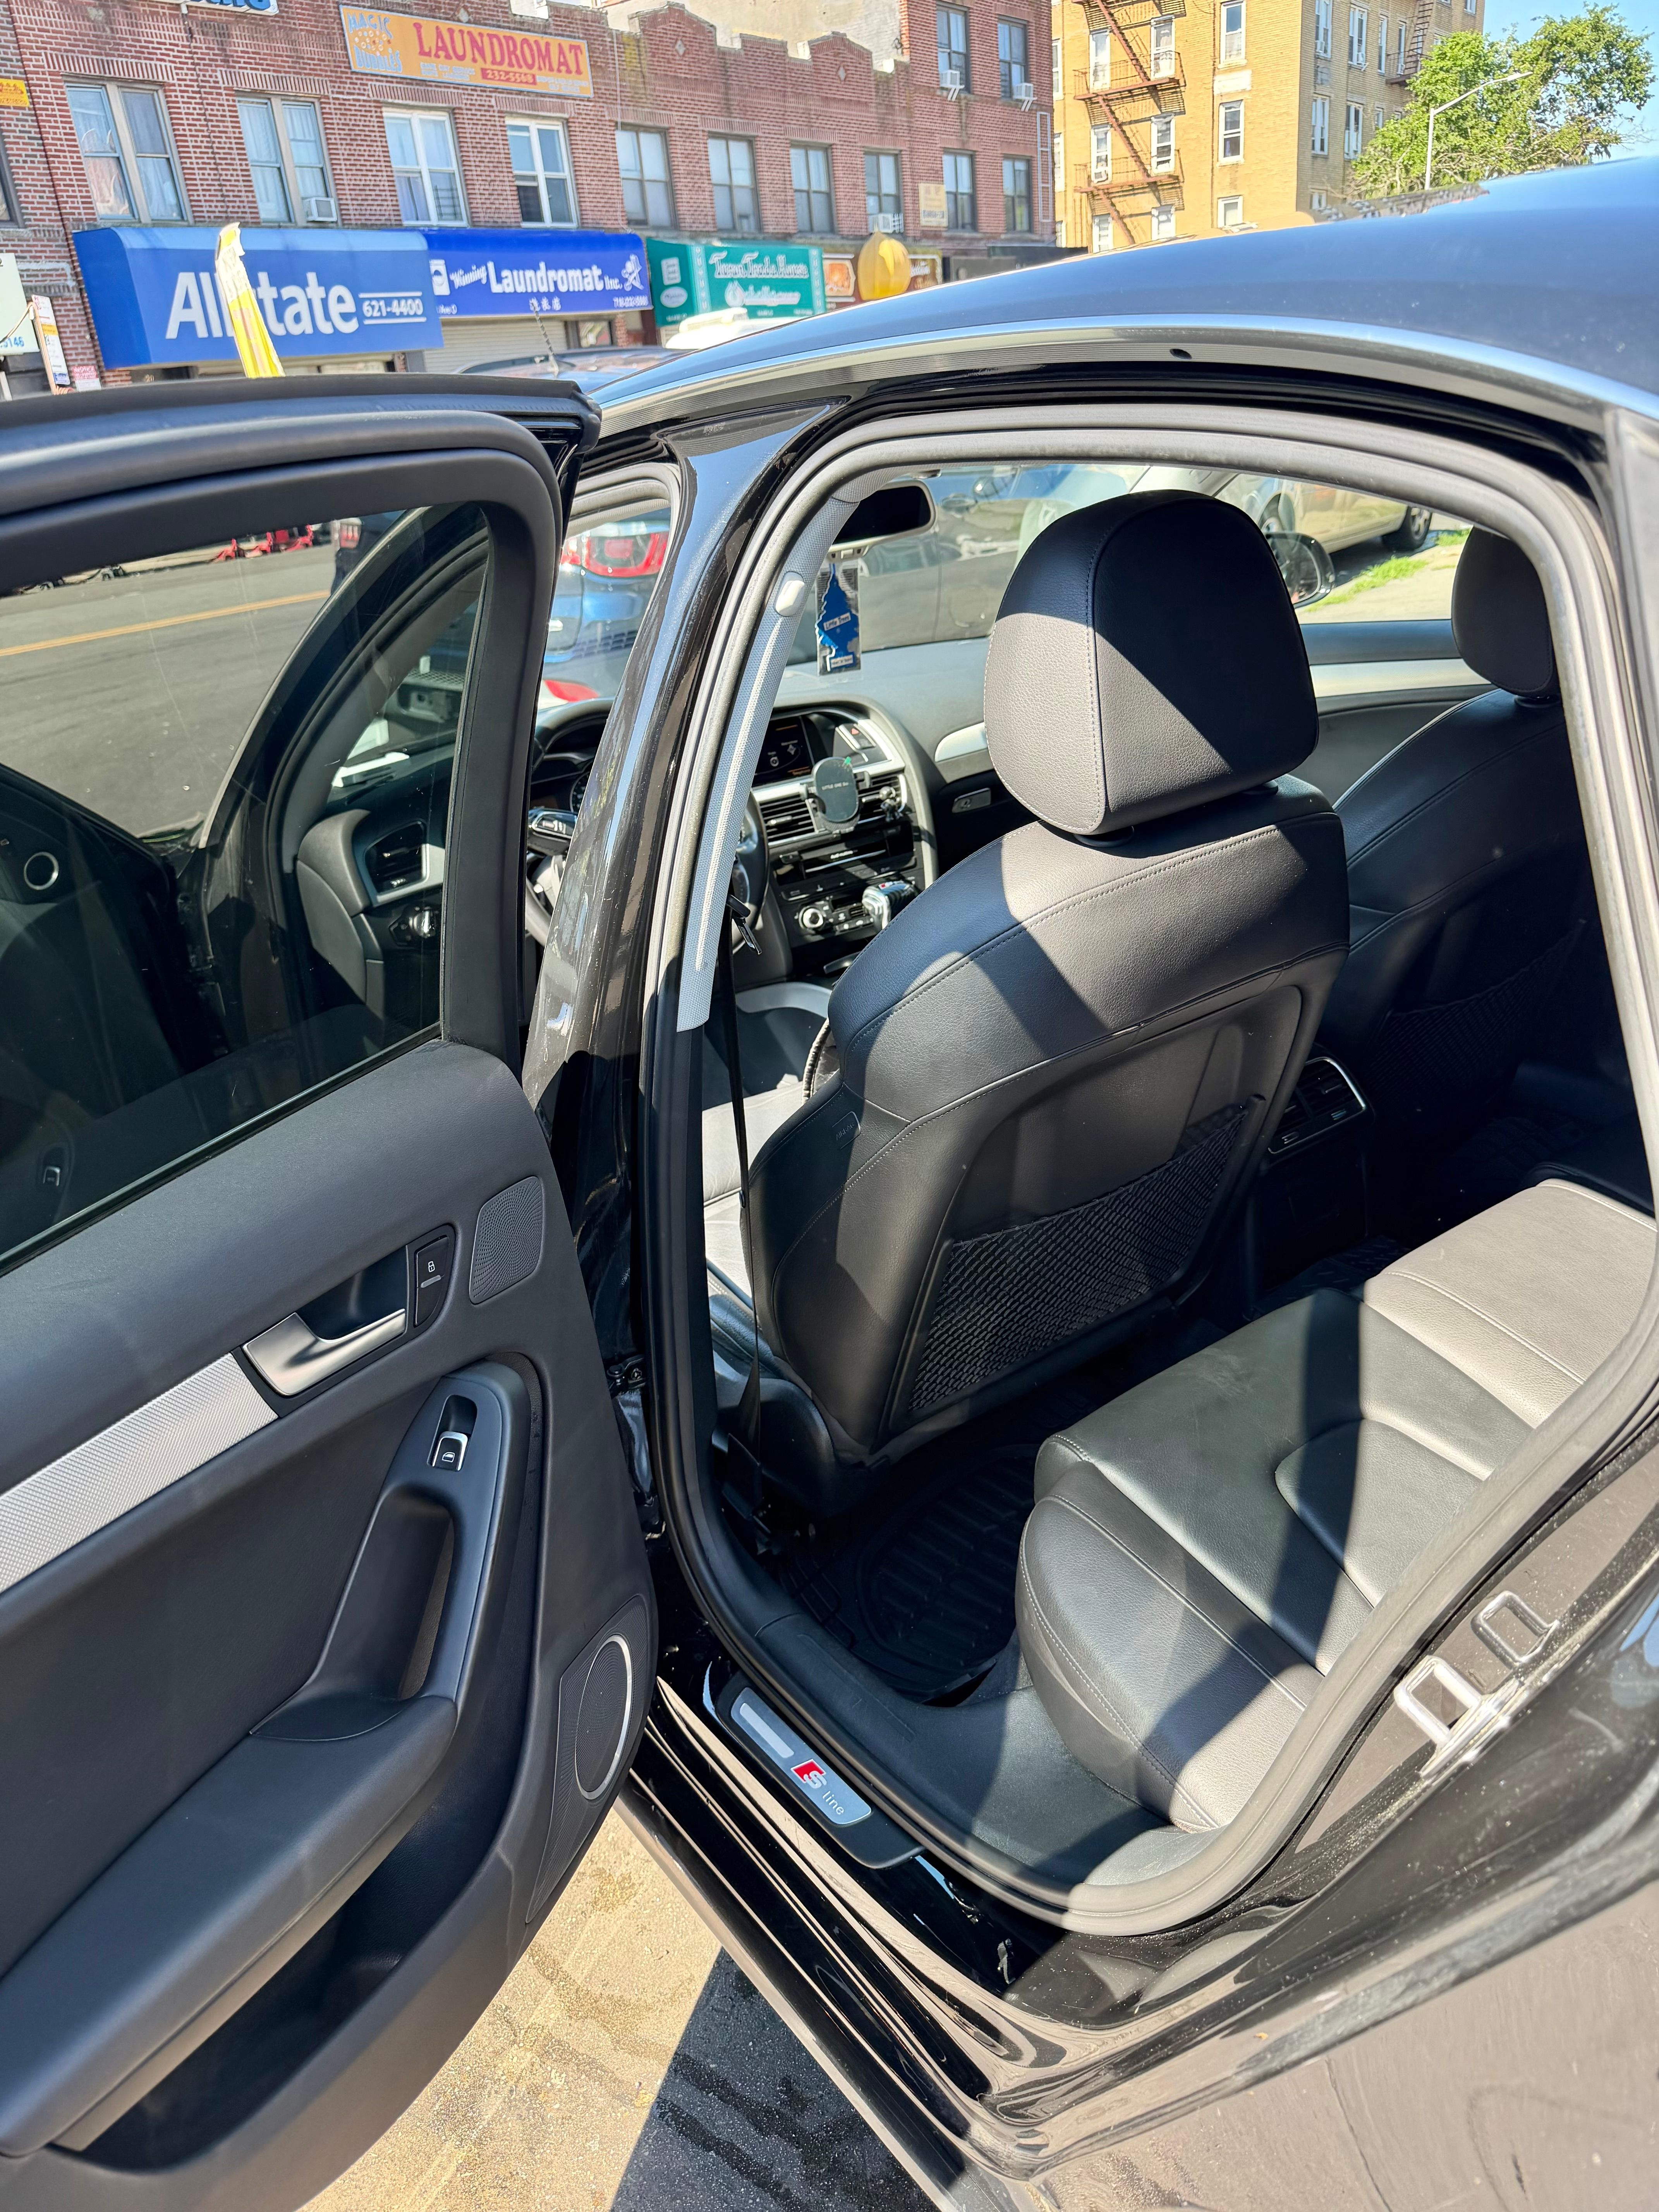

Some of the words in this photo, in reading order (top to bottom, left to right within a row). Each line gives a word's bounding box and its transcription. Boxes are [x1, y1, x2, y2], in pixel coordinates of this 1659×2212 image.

[347, 13, 393, 39] MAGIC
[413, 22, 583, 75] LAUNDROMAT
[487, 261, 604, 294] Laundromat
[165, 271, 359, 339] Alltate
[362, 298, 424, 317] 621-4400
[823, 1791, 844, 1815] line
